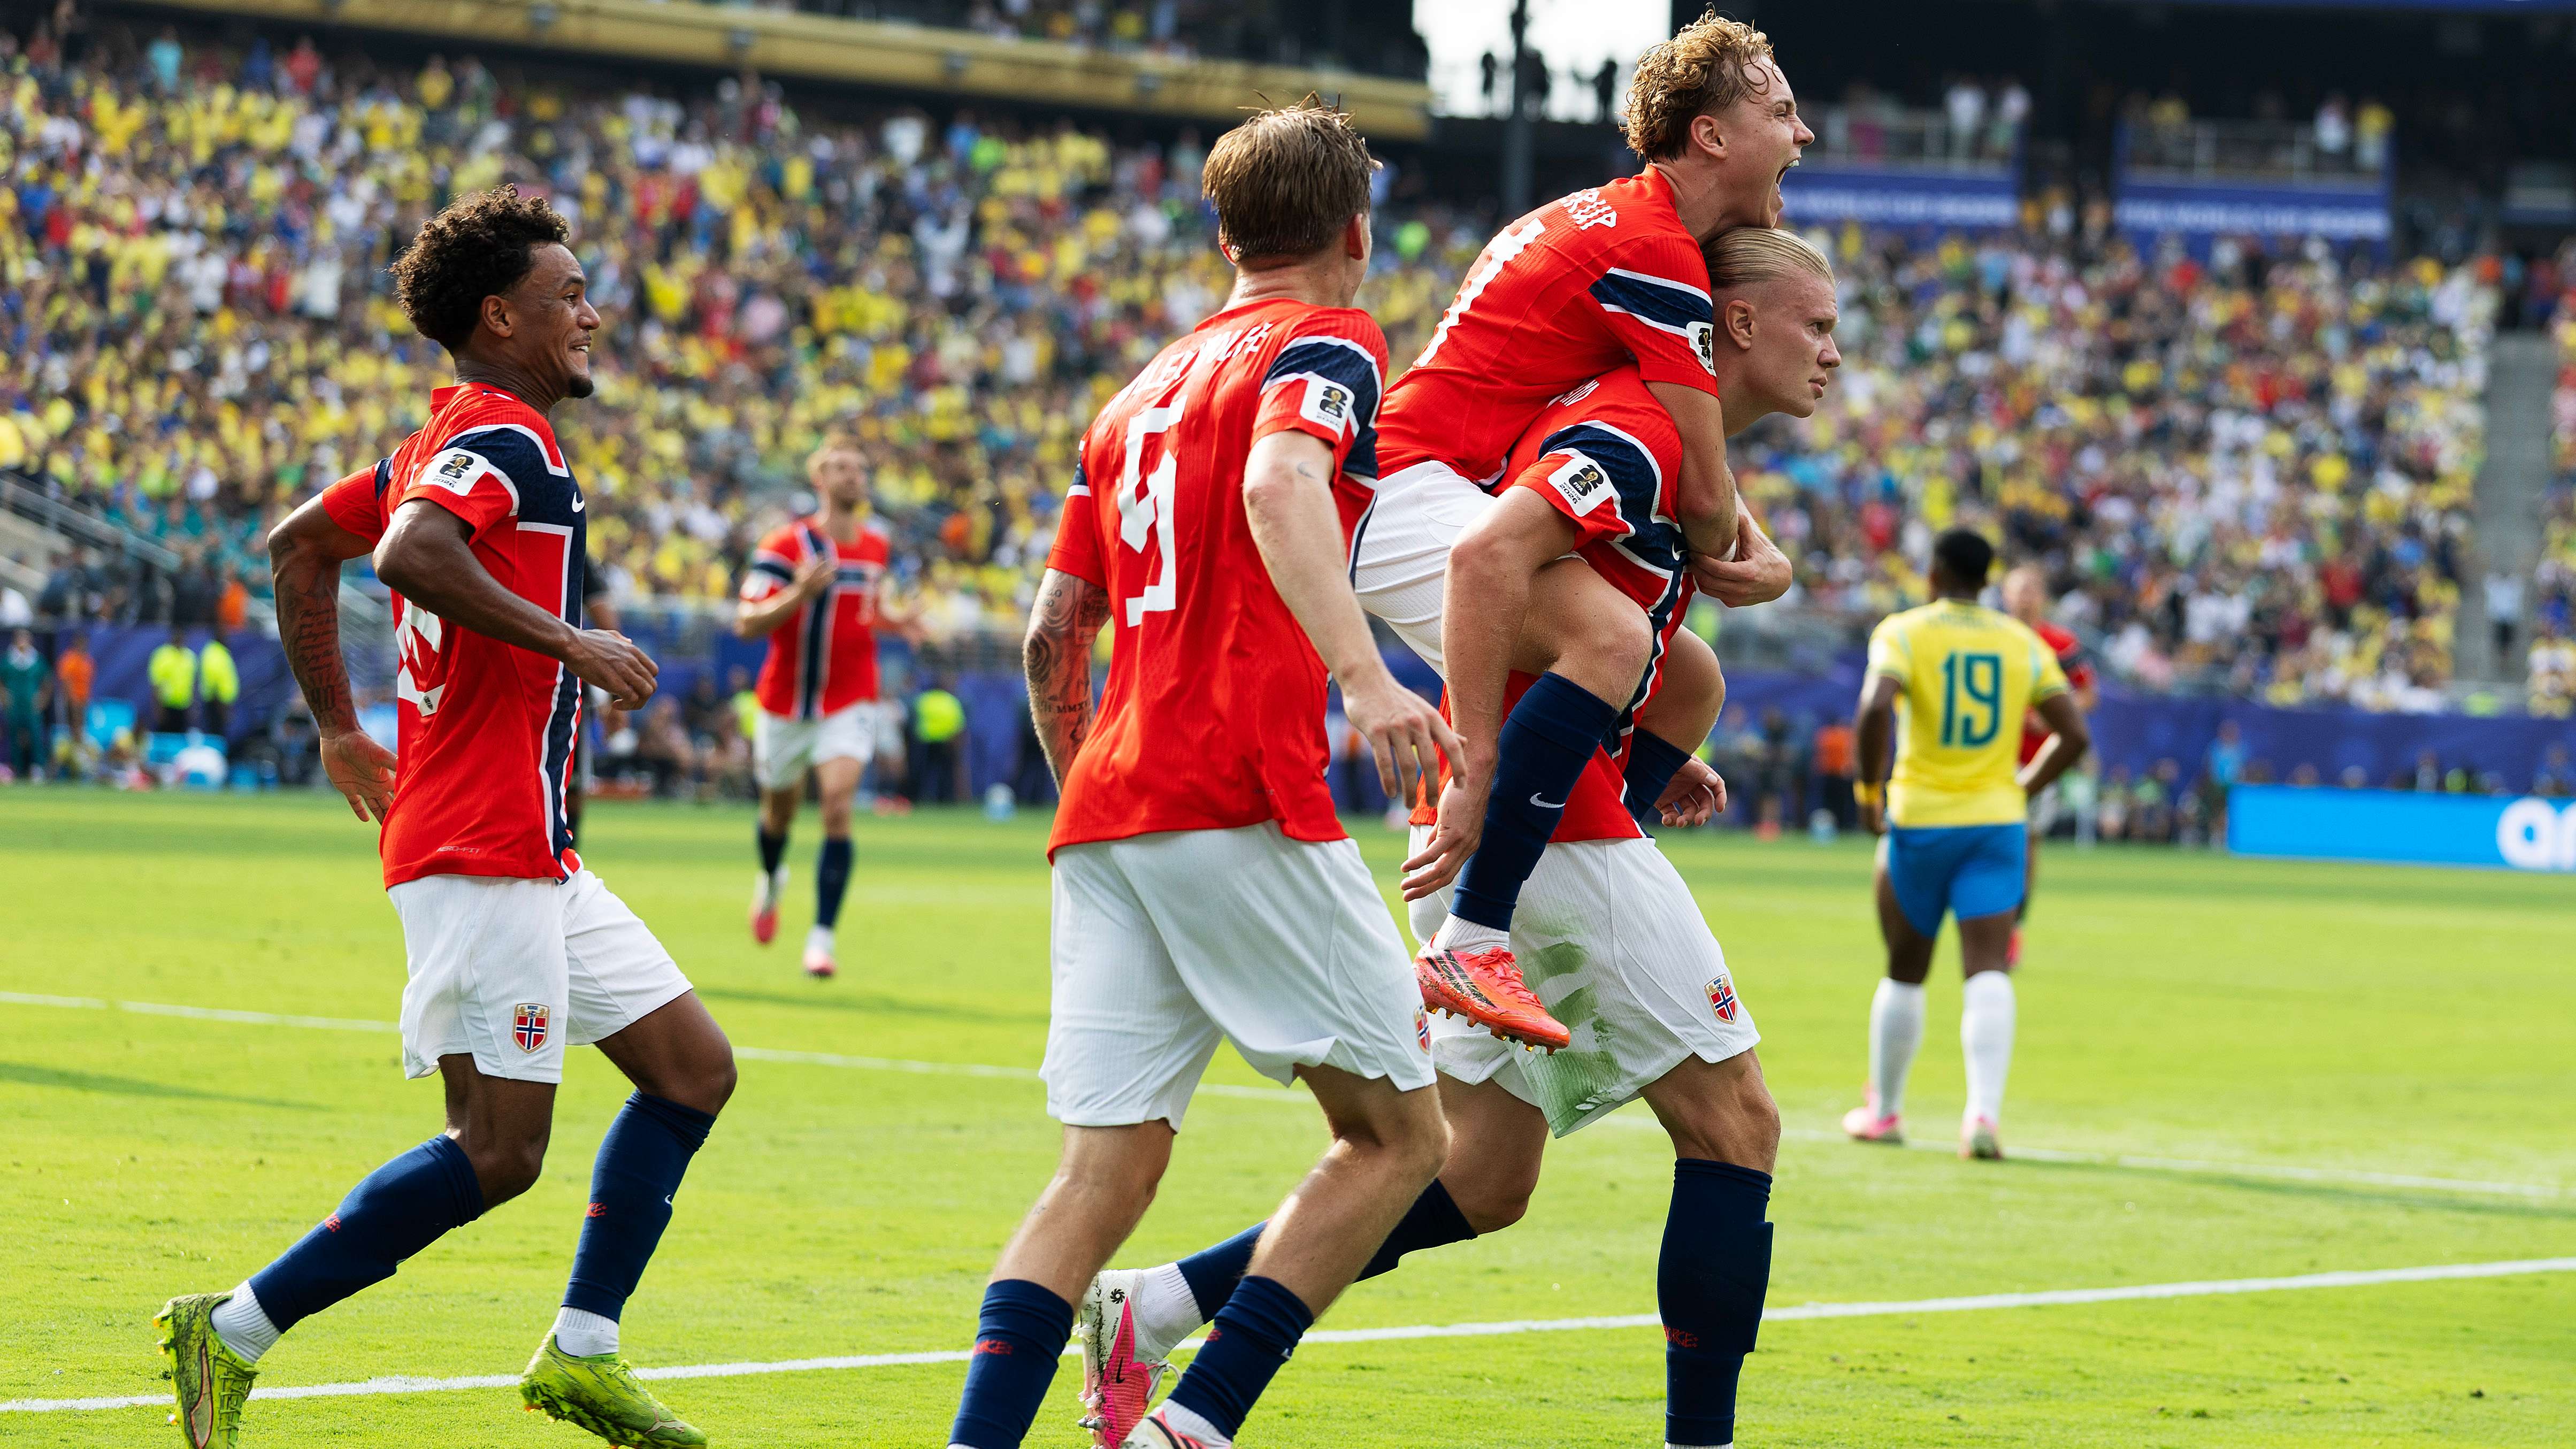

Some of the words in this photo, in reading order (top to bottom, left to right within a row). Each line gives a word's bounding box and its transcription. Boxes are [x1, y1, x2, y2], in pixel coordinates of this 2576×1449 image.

[1559, 484, 1578, 504] 2026
[1563, 482, 1575, 494] WORLD
[1573, 481, 1584, 492] FIFA
[1117, 394, 1187, 628] 5
[1941, 652, 2001, 746] 19
